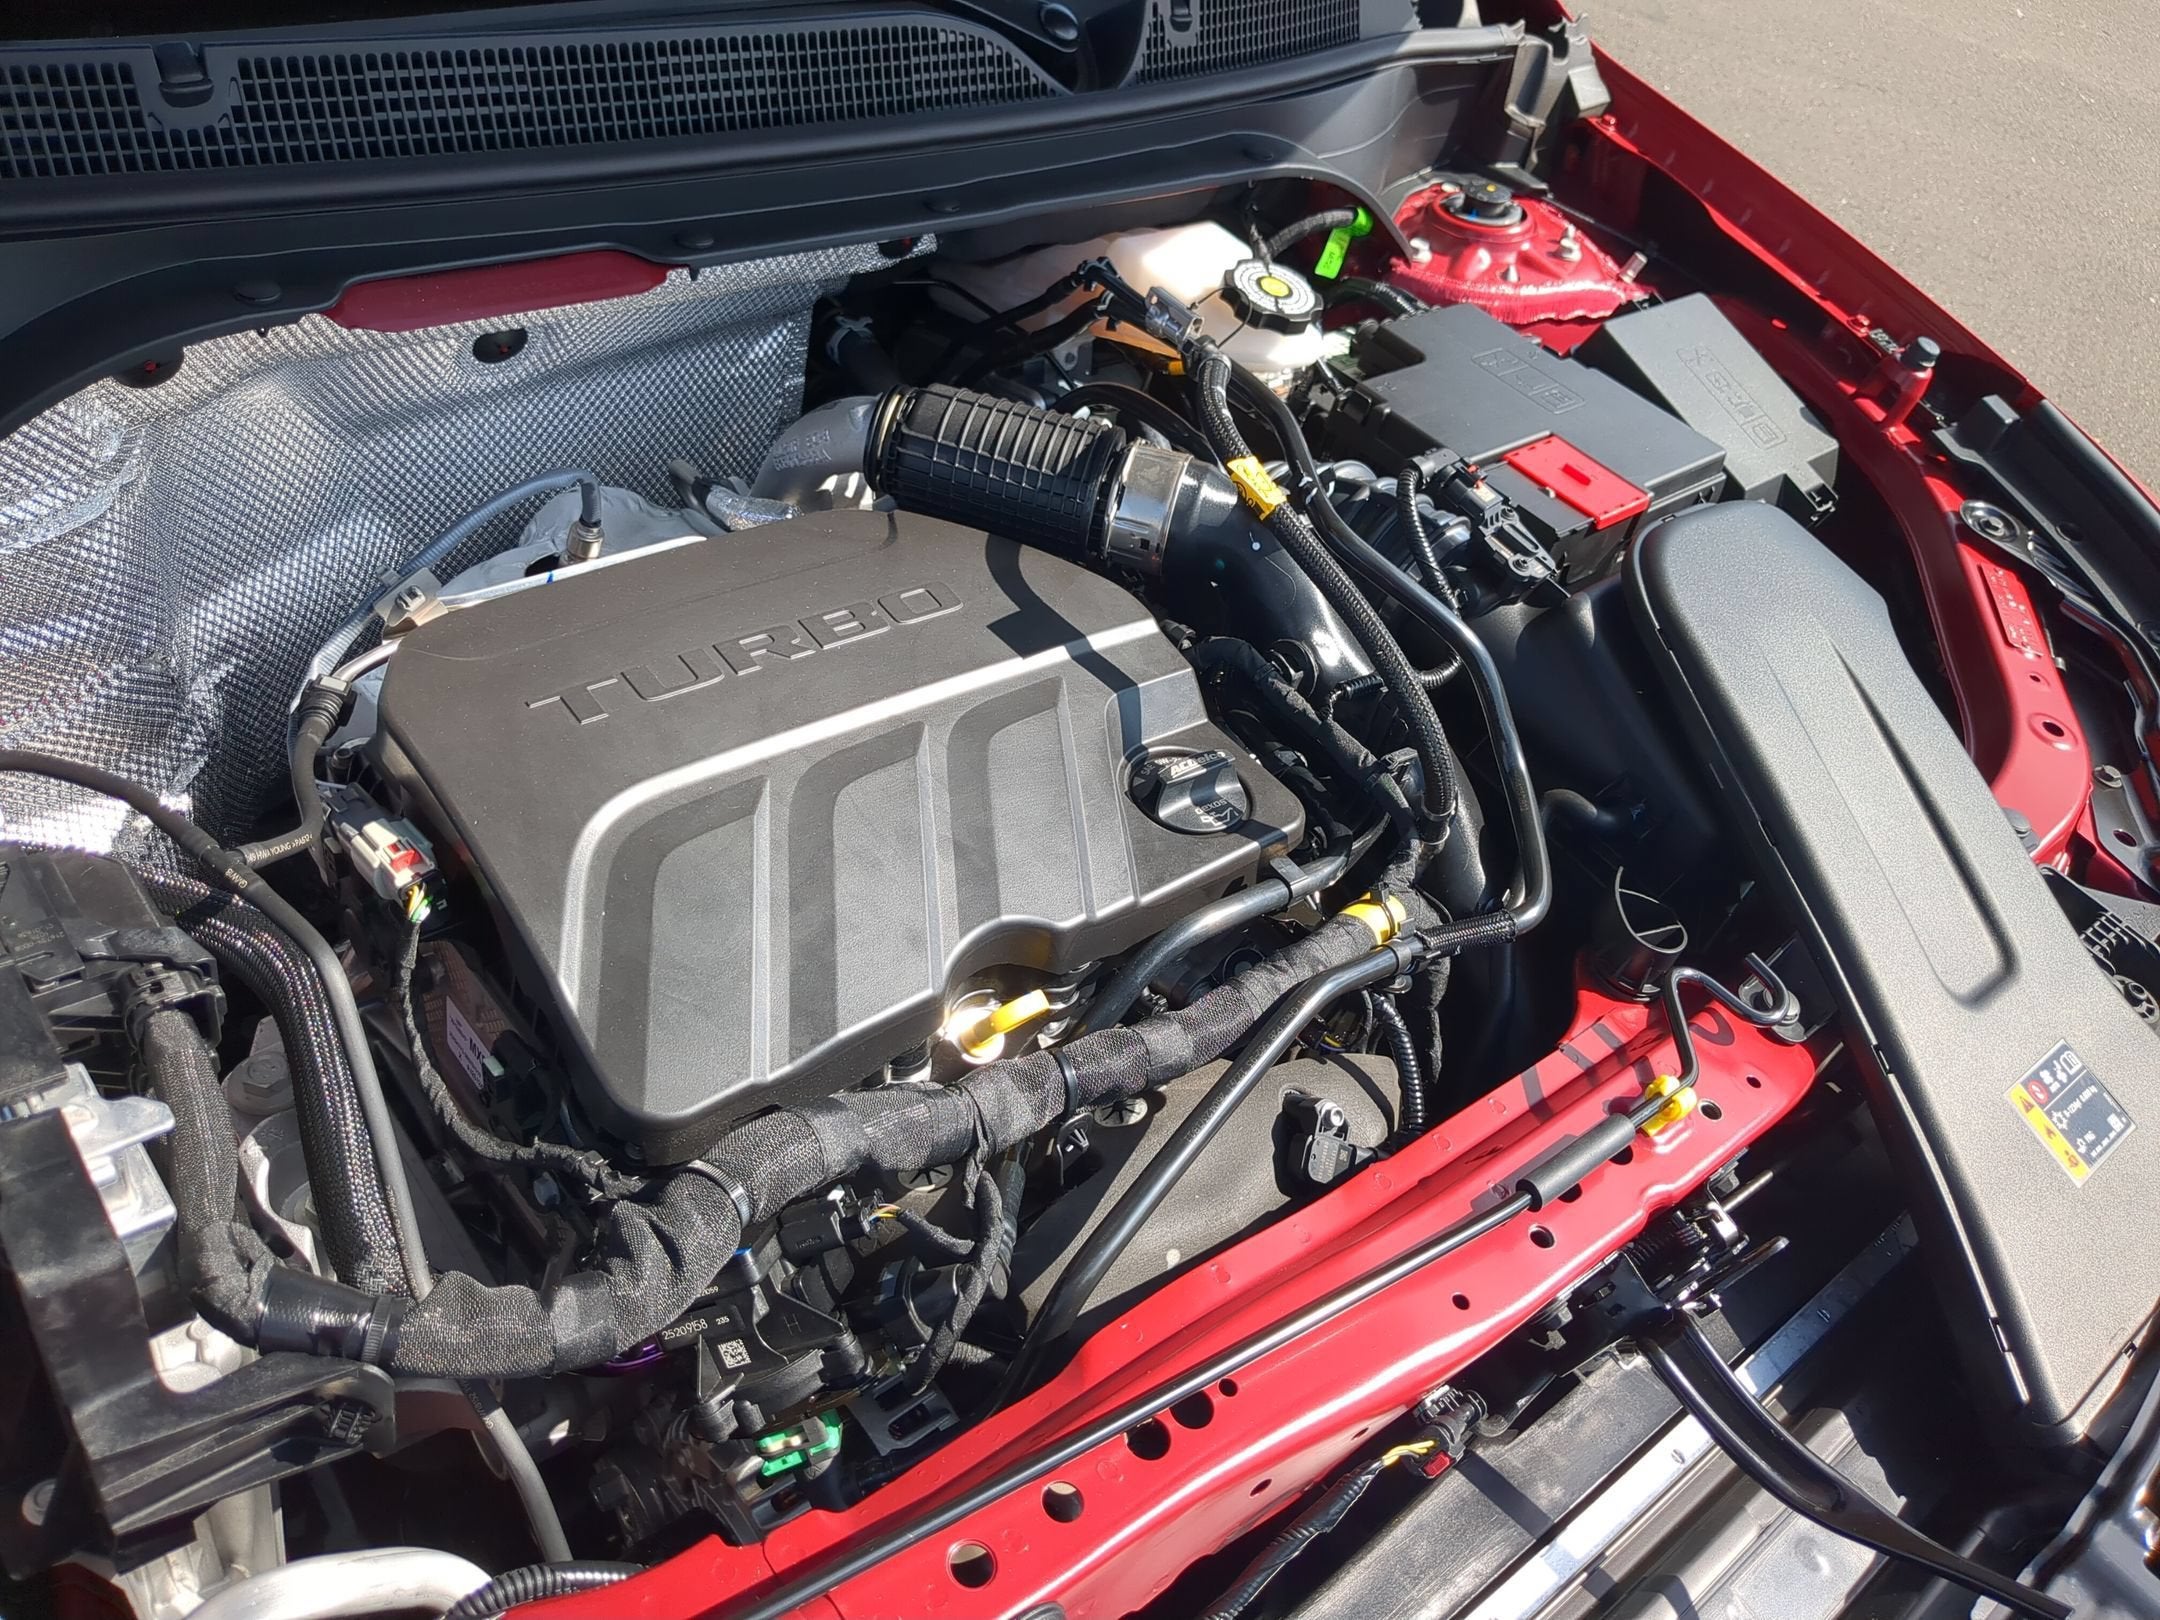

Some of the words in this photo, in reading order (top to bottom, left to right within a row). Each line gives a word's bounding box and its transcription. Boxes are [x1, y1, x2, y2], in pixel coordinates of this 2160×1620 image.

[525, 581, 964, 725] TURBO
[1170, 751, 1227, 777] ACDelco
[1195, 799, 1228, 815] dexos
[662, 1318, 709, 1341] 25209158
